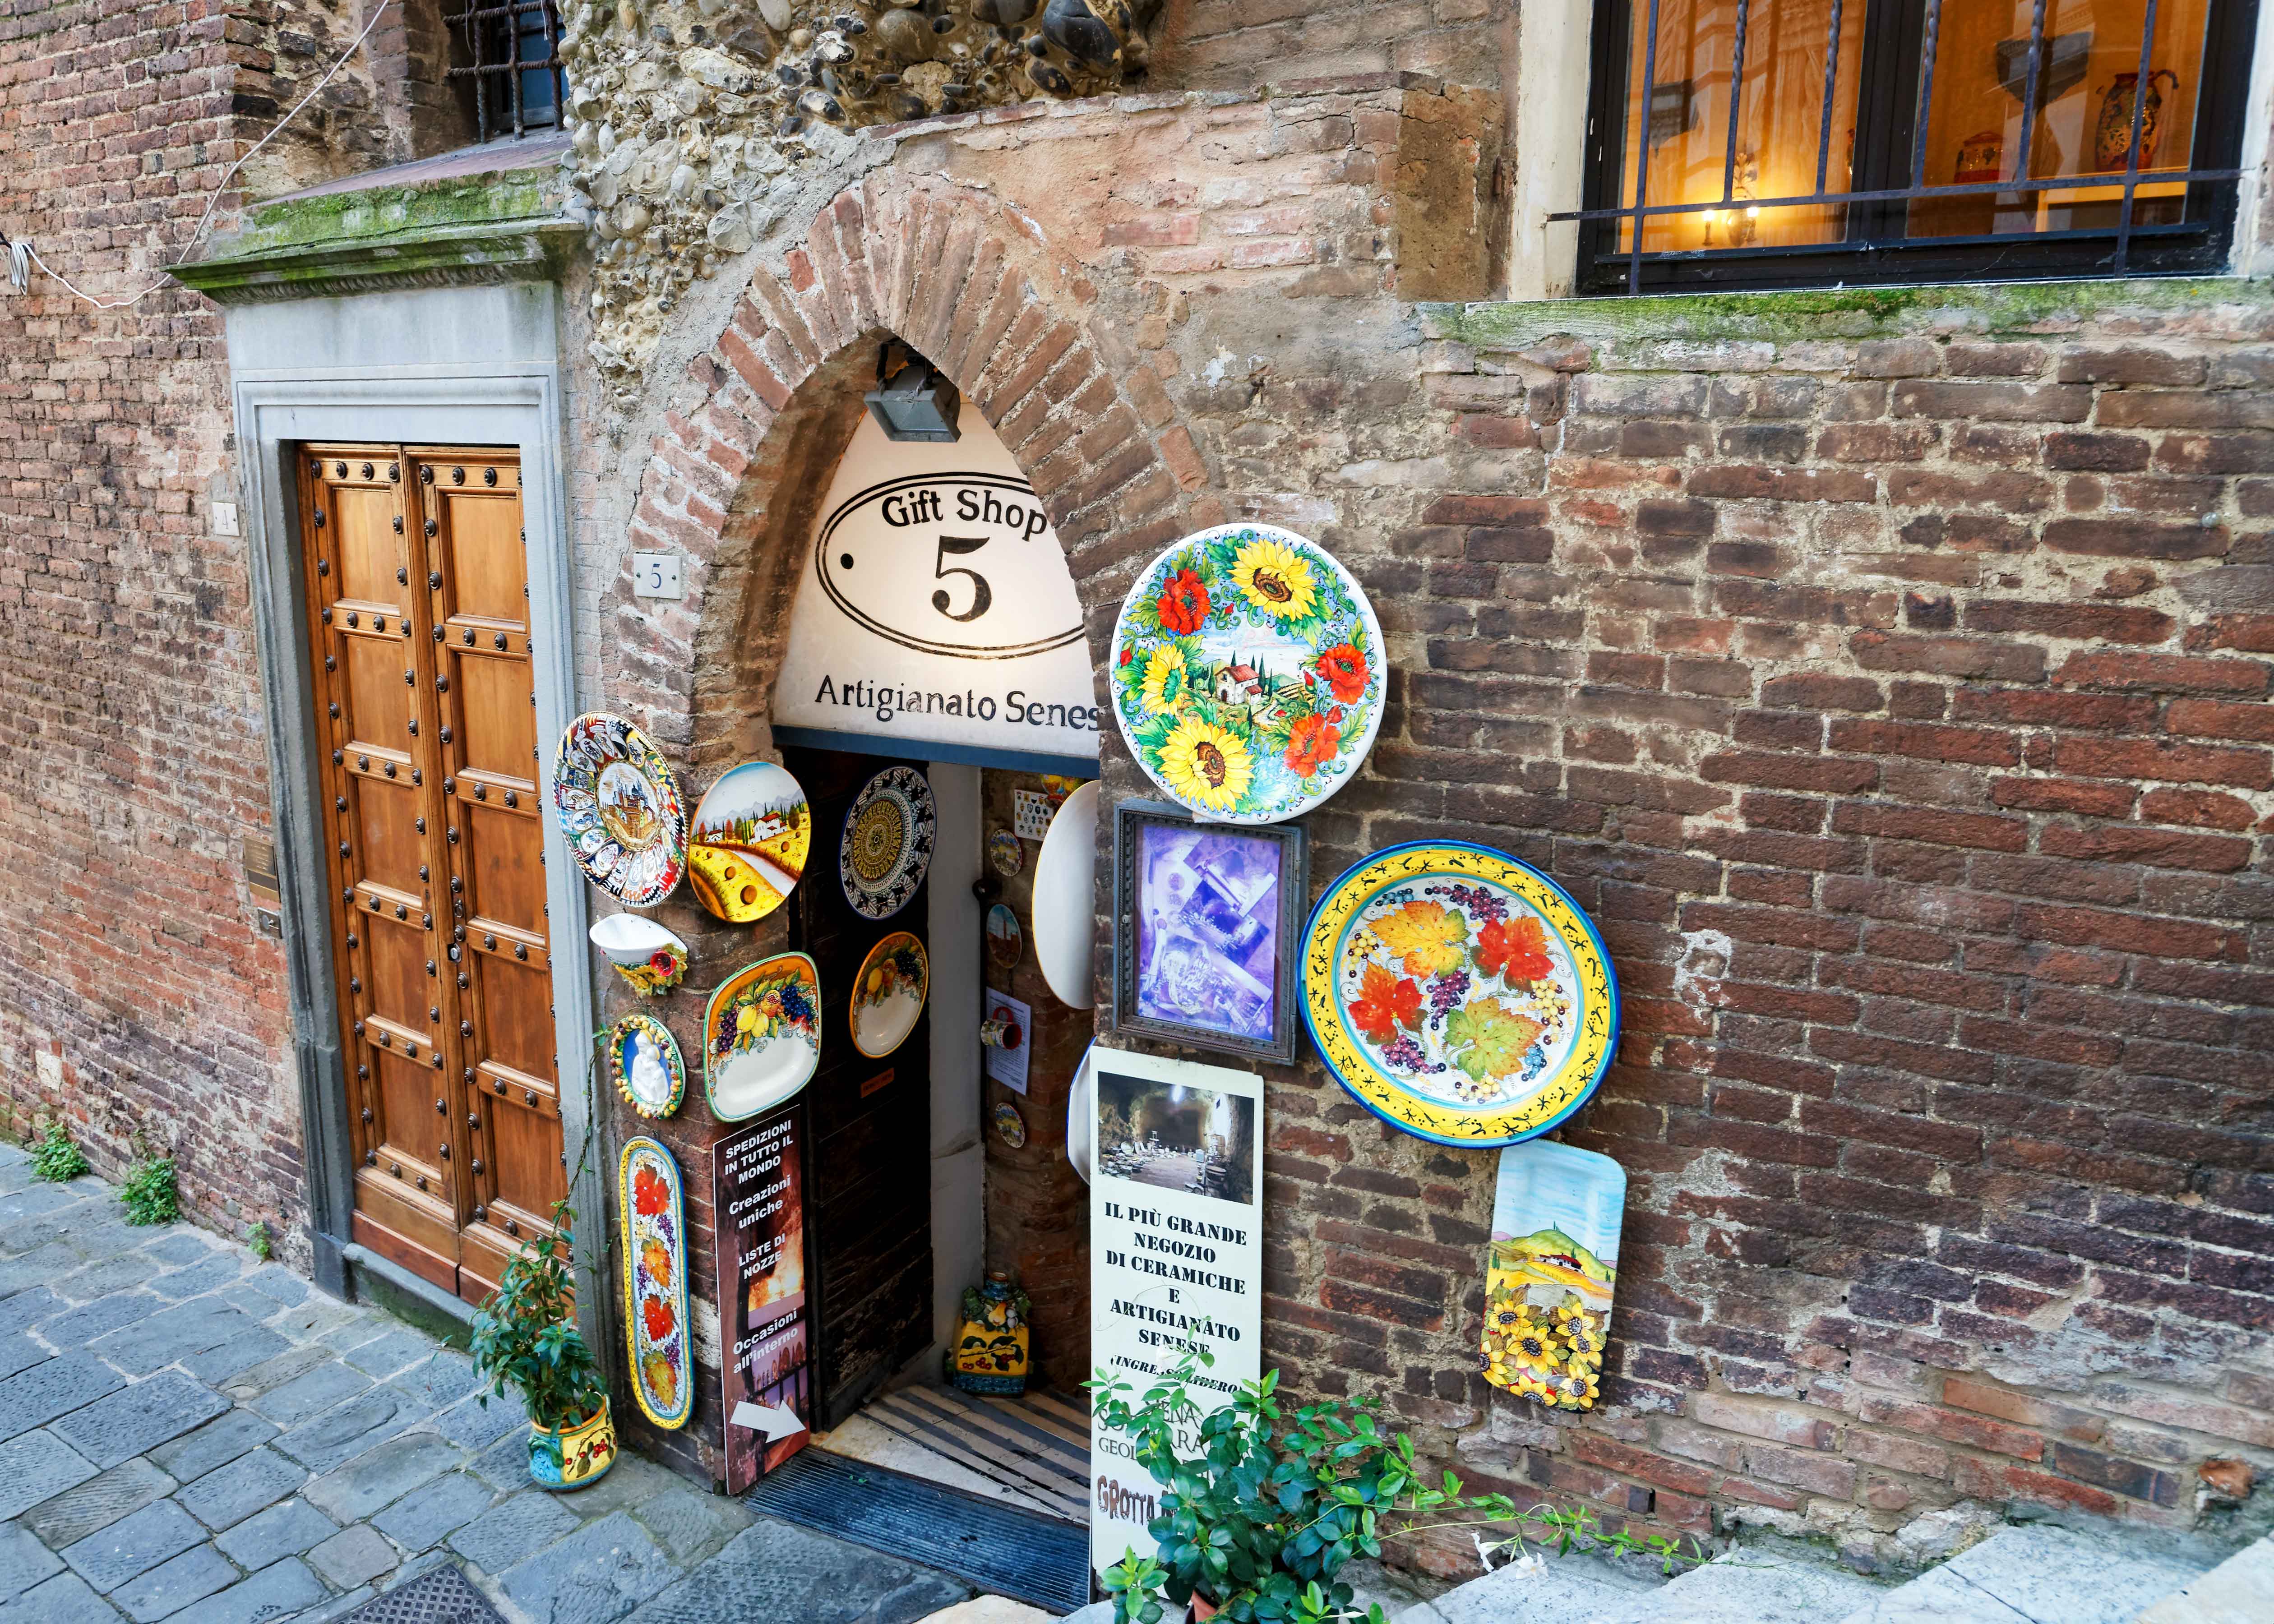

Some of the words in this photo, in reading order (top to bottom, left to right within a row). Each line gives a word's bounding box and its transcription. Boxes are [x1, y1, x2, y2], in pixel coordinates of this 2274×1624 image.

[882, 490, 943, 527] Gift
[957, 489, 1047, 542] Shop
[650, 563, 662, 589] 5
[932, 535, 992, 622] 5
[814, 675, 996, 722] Artigianato
[725, 1161, 738, 1176] IN
[741, 1141, 779, 1167] TUTTO
[783, 1135, 793, 1147] IL
[726, 1120, 791, 1159] SPEDIZIONI
[738, 1155, 781, 1184] MONDO
[729, 1174, 791, 1215] Creazioni
[739, 1199, 783, 1229] uniche
[1105, 1202, 1123, 1219] IL
[1128, 1207, 1160, 1227] PIÙ
[1167, 1216, 1247, 1246] GRANDE
[739, 1241, 771, 1268] LISTE
[774, 1233, 786, 1248] DI
[744, 1250, 781, 1280] NOZZE
[1134, 1232, 1216, 1263] NEGOZIO
[1106, 1250, 1125, 1267] DI
[1131, 1256, 1245, 1295] CERAMICHE
[1169, 1288, 1180, 1304] E
[733, 1307, 797, 1355] Occasioni
[1110, 1299, 1240, 1341] ARTIGIANATO
[733, 1328, 798, 1374] all'interno
[1139, 1329, 1210, 1354] SENESE
